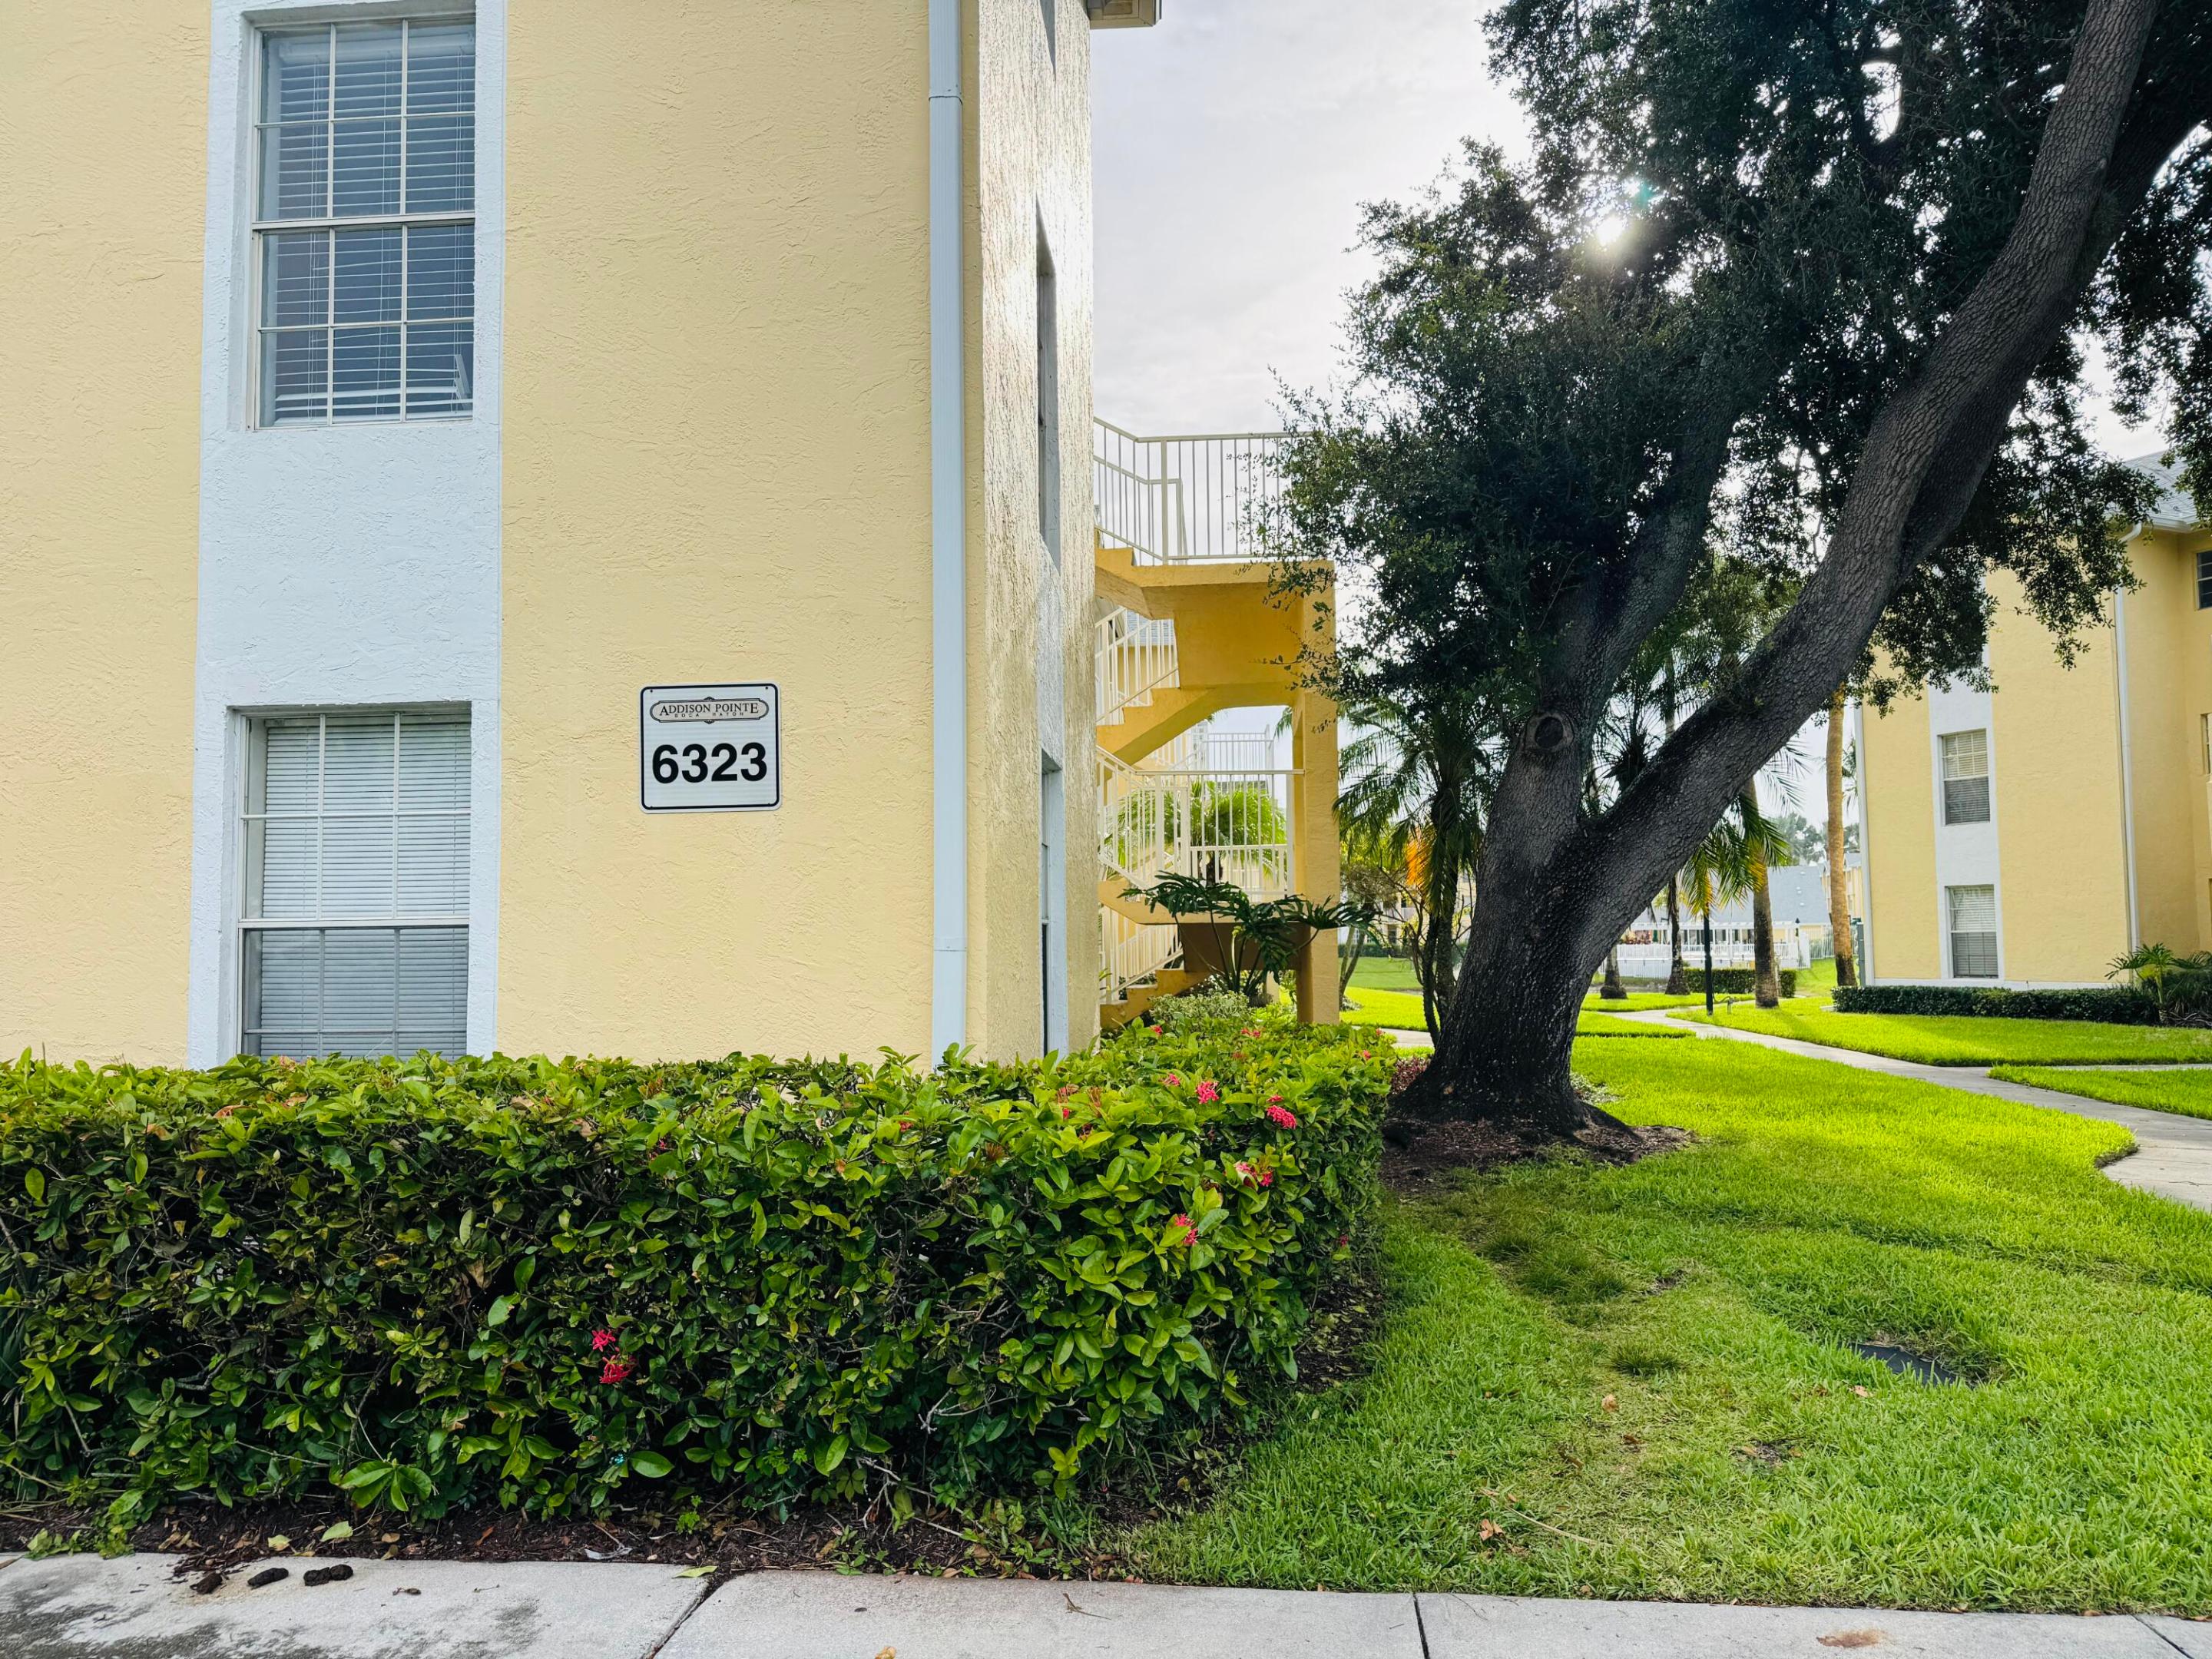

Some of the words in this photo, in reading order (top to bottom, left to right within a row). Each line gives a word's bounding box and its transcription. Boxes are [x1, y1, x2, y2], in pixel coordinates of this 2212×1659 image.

[659, 704, 710, 716] ADDISON
[715, 703, 759, 714] POINTE
[652, 742, 767, 784] 6323
